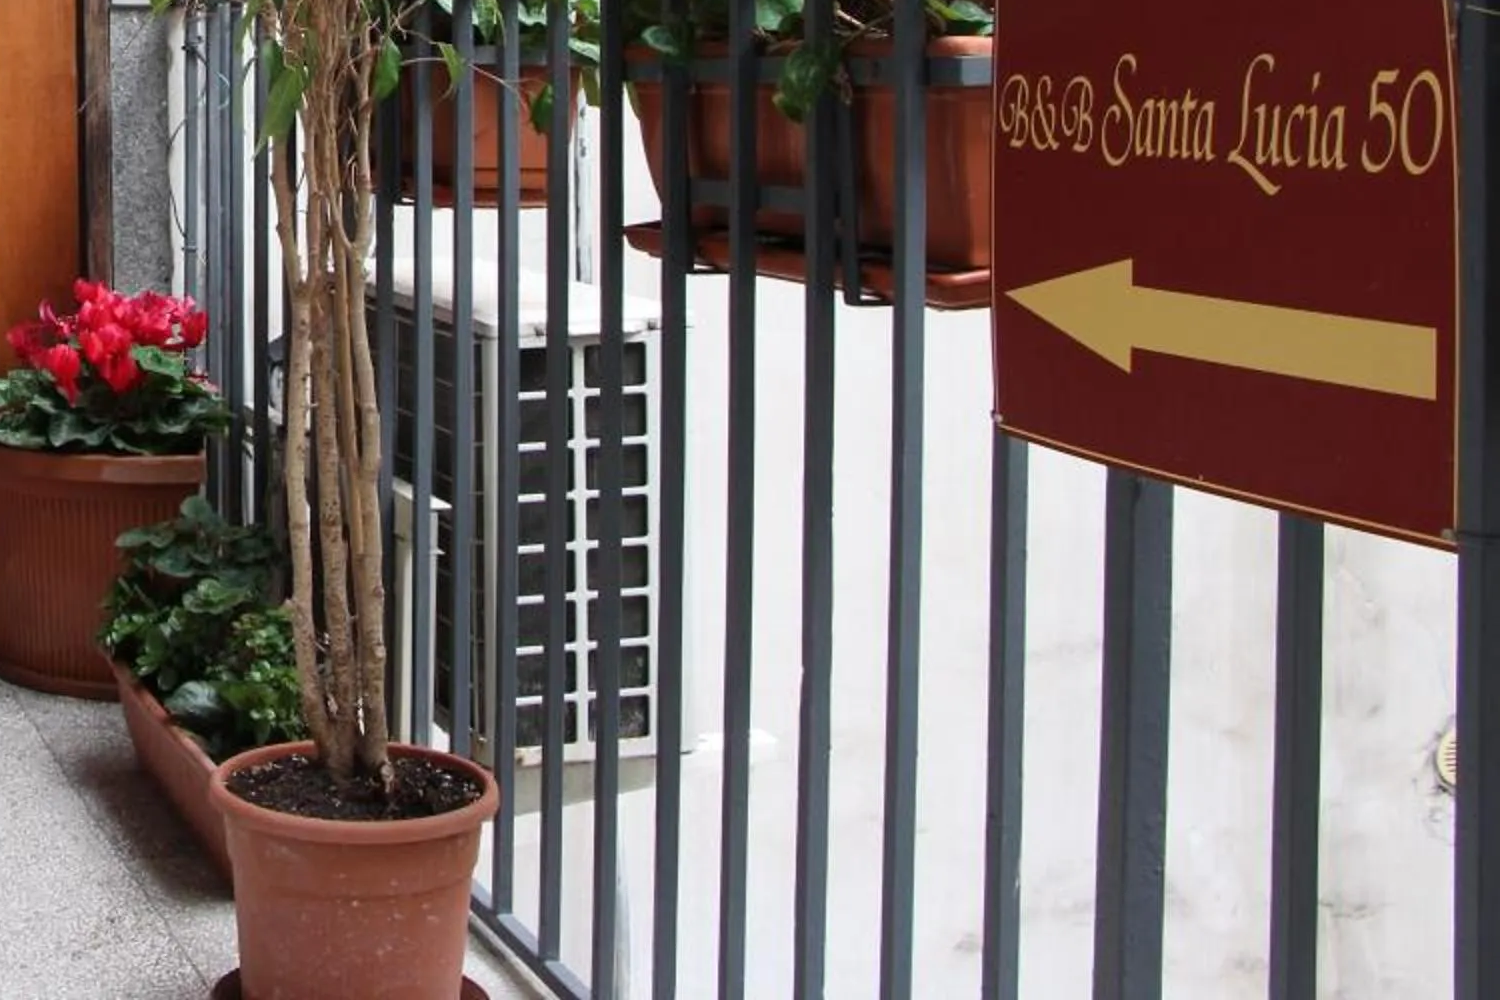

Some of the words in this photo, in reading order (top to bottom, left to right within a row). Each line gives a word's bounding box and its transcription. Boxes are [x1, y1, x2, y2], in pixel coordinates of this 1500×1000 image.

[1000, 74, 1094, 153] B&B
[1101, 53, 1217, 167] Santa
[1228, 53, 1348, 196] Lucia
[1362, 69, 1444, 176] 50
